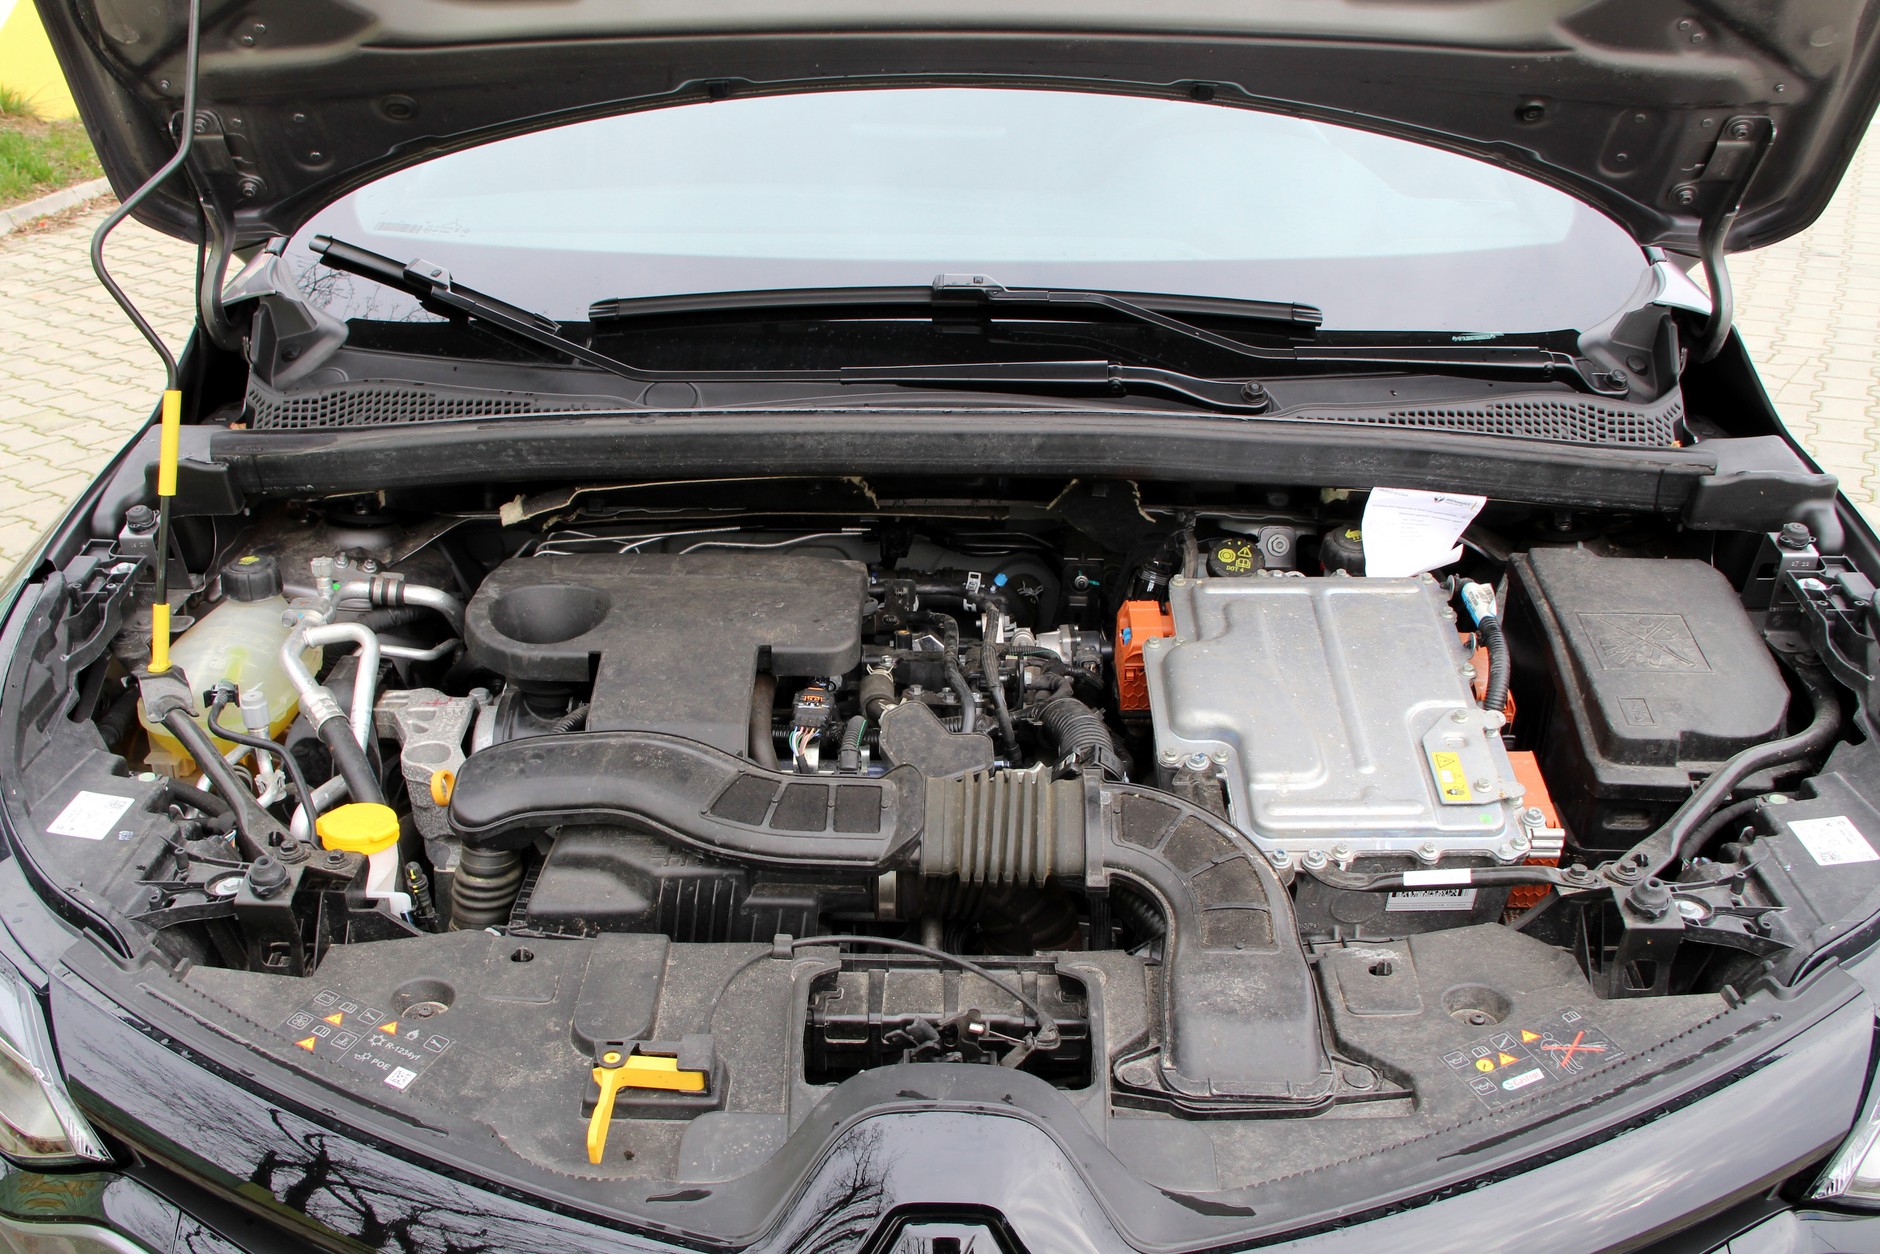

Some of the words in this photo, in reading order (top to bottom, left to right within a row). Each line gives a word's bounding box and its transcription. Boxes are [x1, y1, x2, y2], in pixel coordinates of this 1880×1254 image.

[384, 1042, 421, 1062] R-1234yf
[370, 1058, 391, 1071] POE
[1512, 1071, 1541, 1087] Castrol
